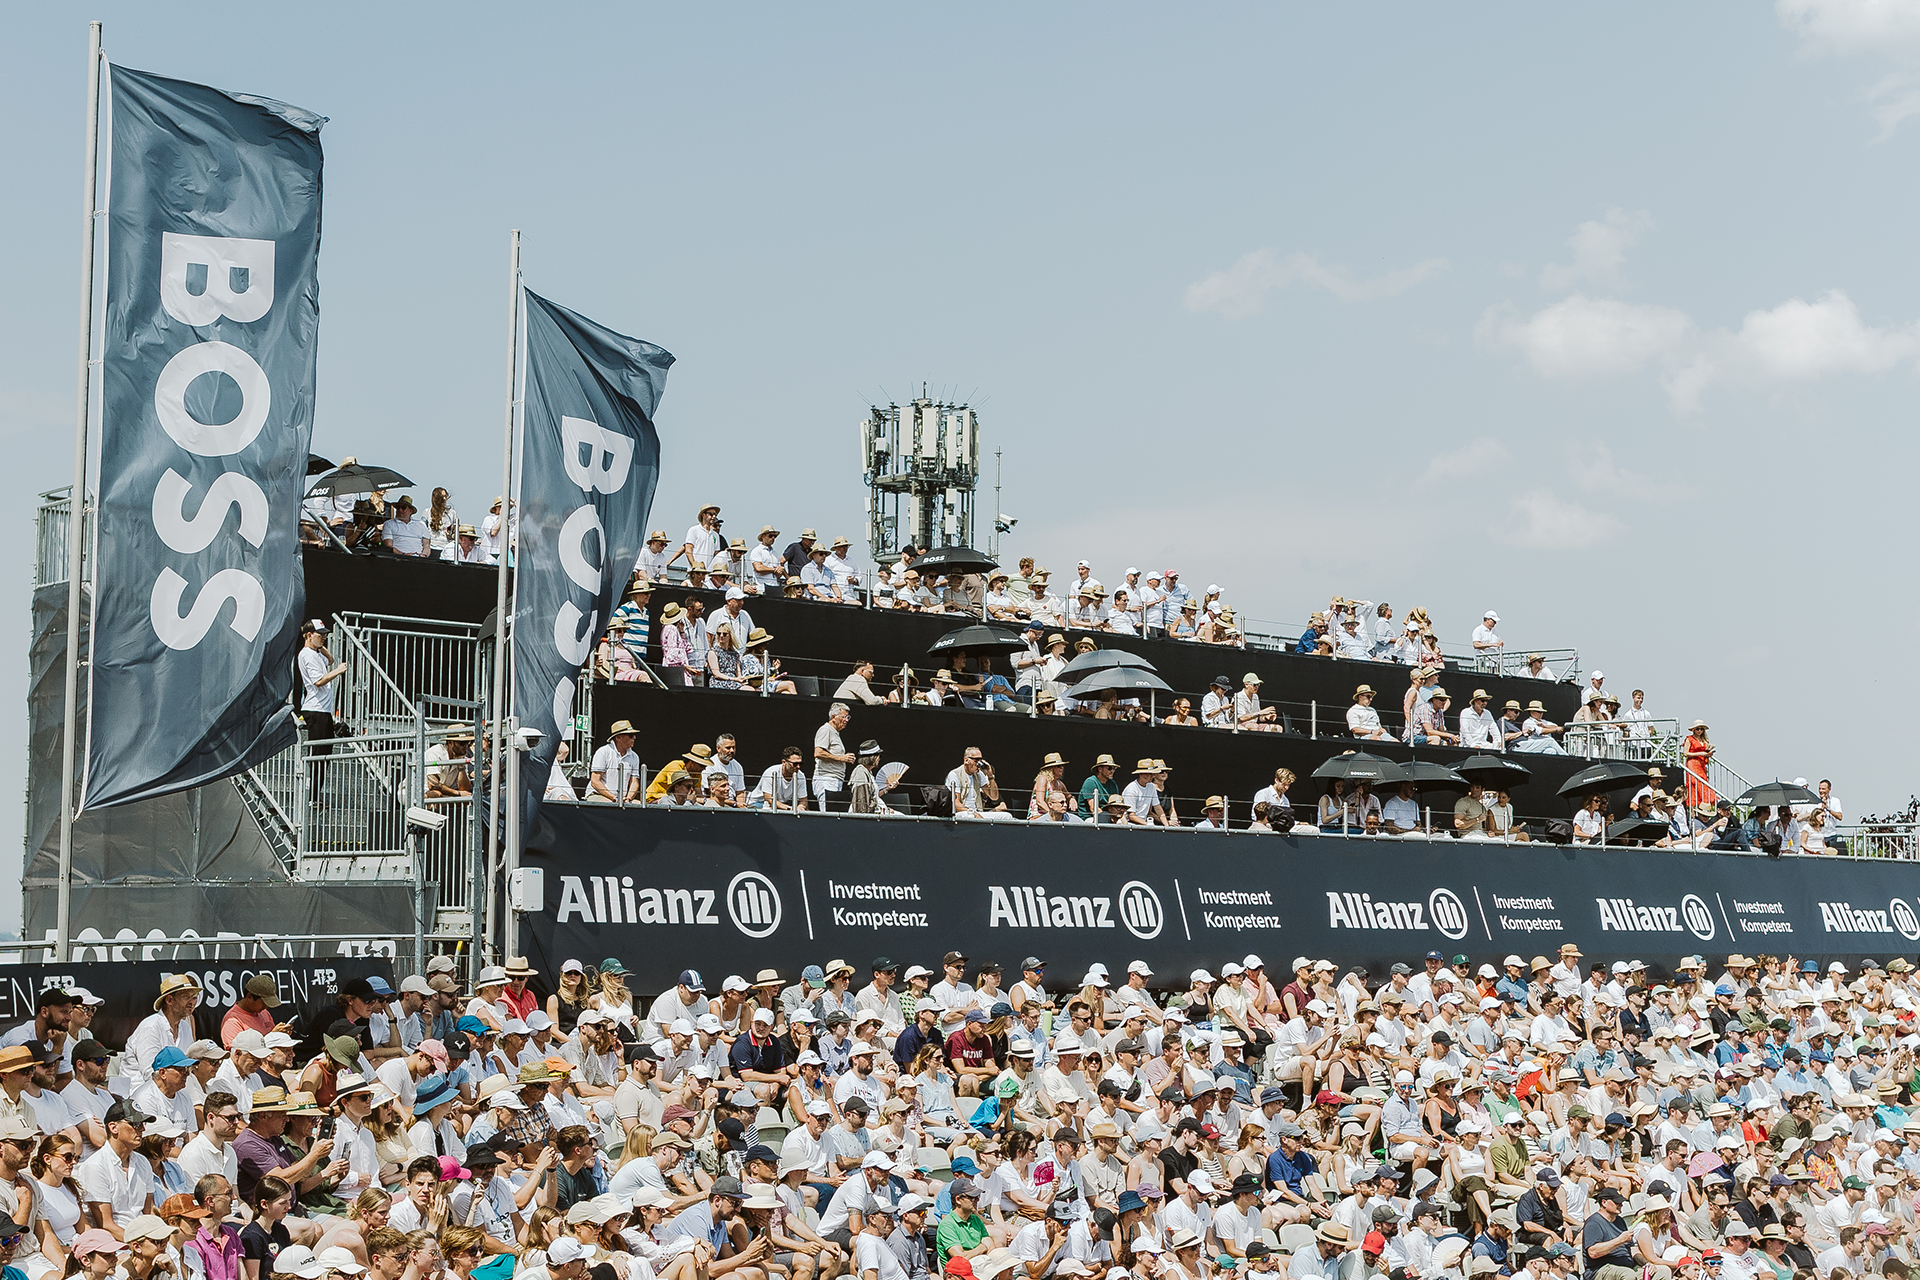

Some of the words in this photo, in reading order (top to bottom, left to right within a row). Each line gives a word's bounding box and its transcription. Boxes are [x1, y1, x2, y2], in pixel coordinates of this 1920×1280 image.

[150, 231, 275, 651] BOSS
[311, 487, 330, 496] BOSS
[923, 555, 946, 563] BOSS
[554, 415, 635, 741] BOS
[557, 875, 719, 924] Allianz
[828, 879, 921, 901] Investment
[1198, 887, 1273, 906] Investment
[988, 886, 1116, 928] Allianz
[1325, 891, 1430, 930] Allianz
[1492, 893, 1555, 910] Investment
[1732, 899, 1785, 914] Investment
[833, 906, 929, 931] Kompetenz
[1203, 911, 1282, 932] Kompetenz
[1499, 914, 1564, 934] Kompetenz
[1595, 897, 1684, 932] Allianz
[1817, 902, 1894, 932] Allianz
[1739, 918, 1794, 936] Kompetenz
